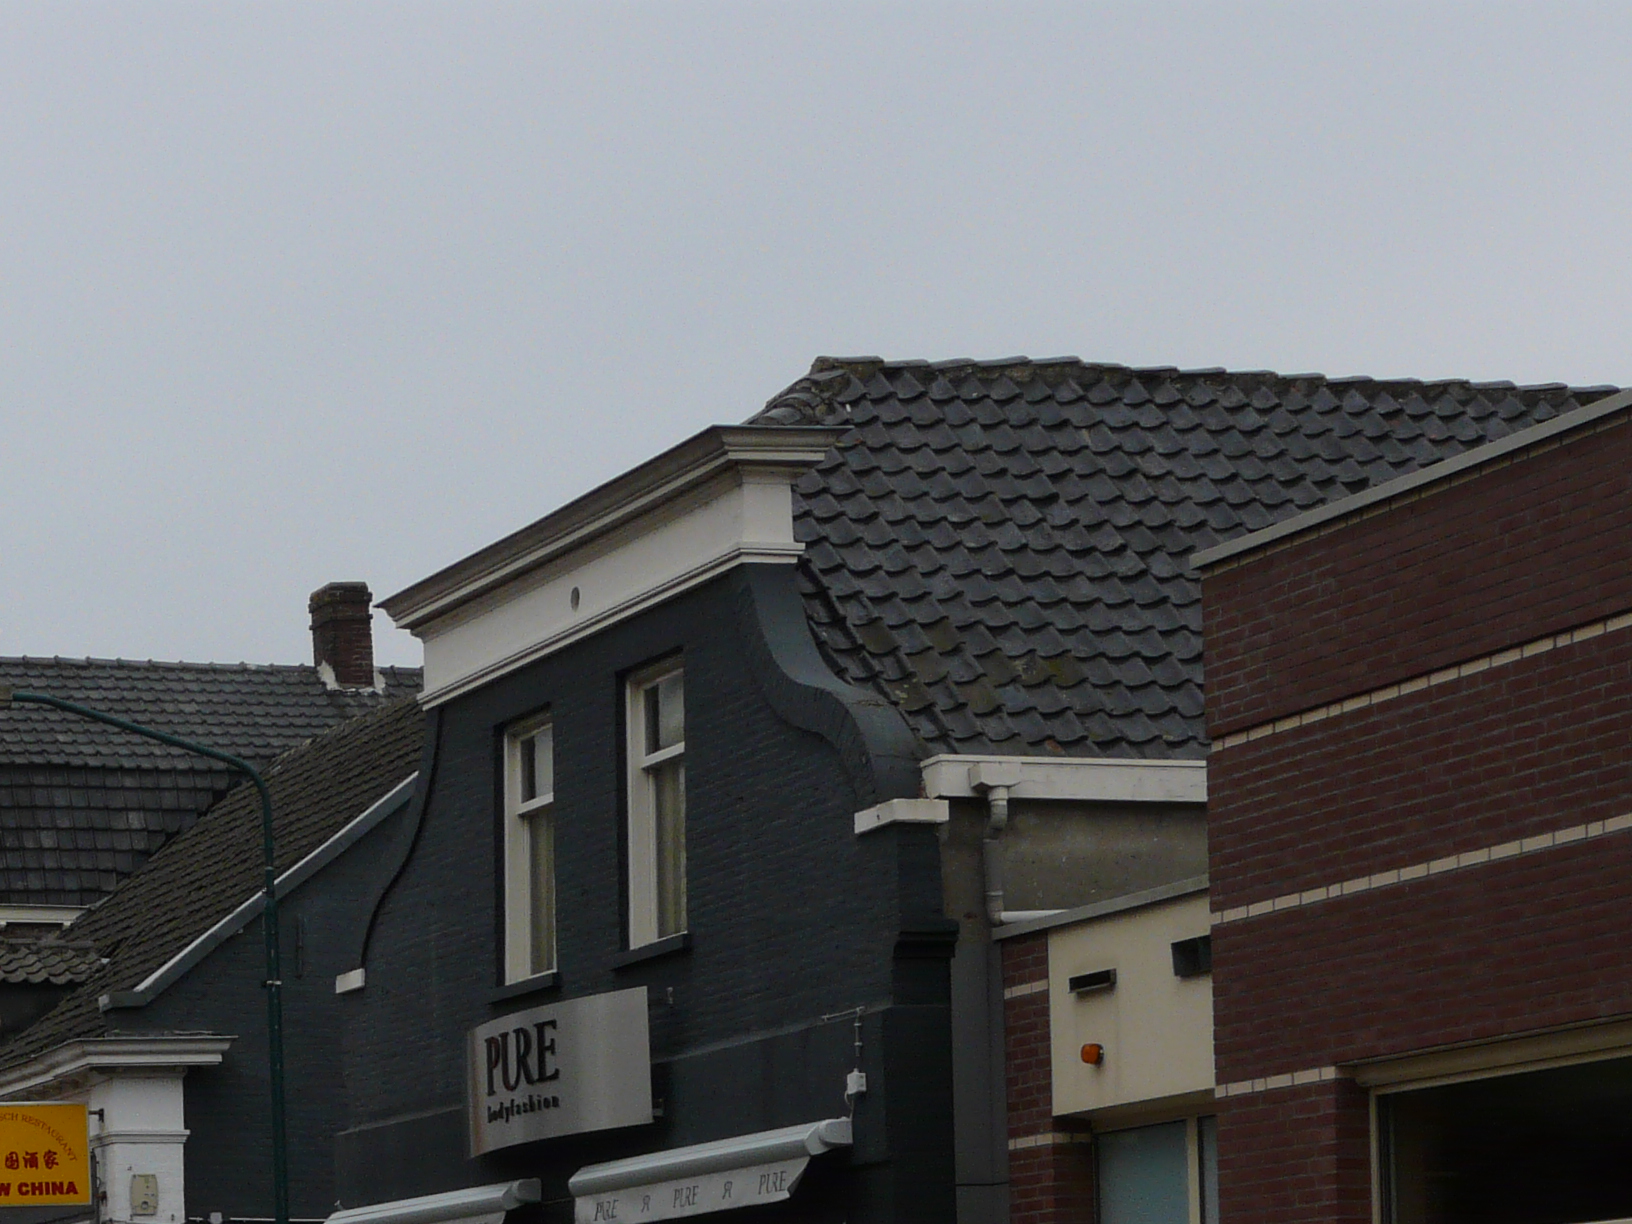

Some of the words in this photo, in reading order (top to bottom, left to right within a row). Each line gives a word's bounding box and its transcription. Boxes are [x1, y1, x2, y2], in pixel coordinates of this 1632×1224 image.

[485, 1019, 560, 1097] PURE
[487, 1094, 560, 1124] bodyfashion
[21, 1114, 78, 1162] RESTAURANT
[17, 1181, 79, 1196] CHINA
[672, 1185, 699, 1209] PURE
[758, 1170, 787, 1195] PURE
